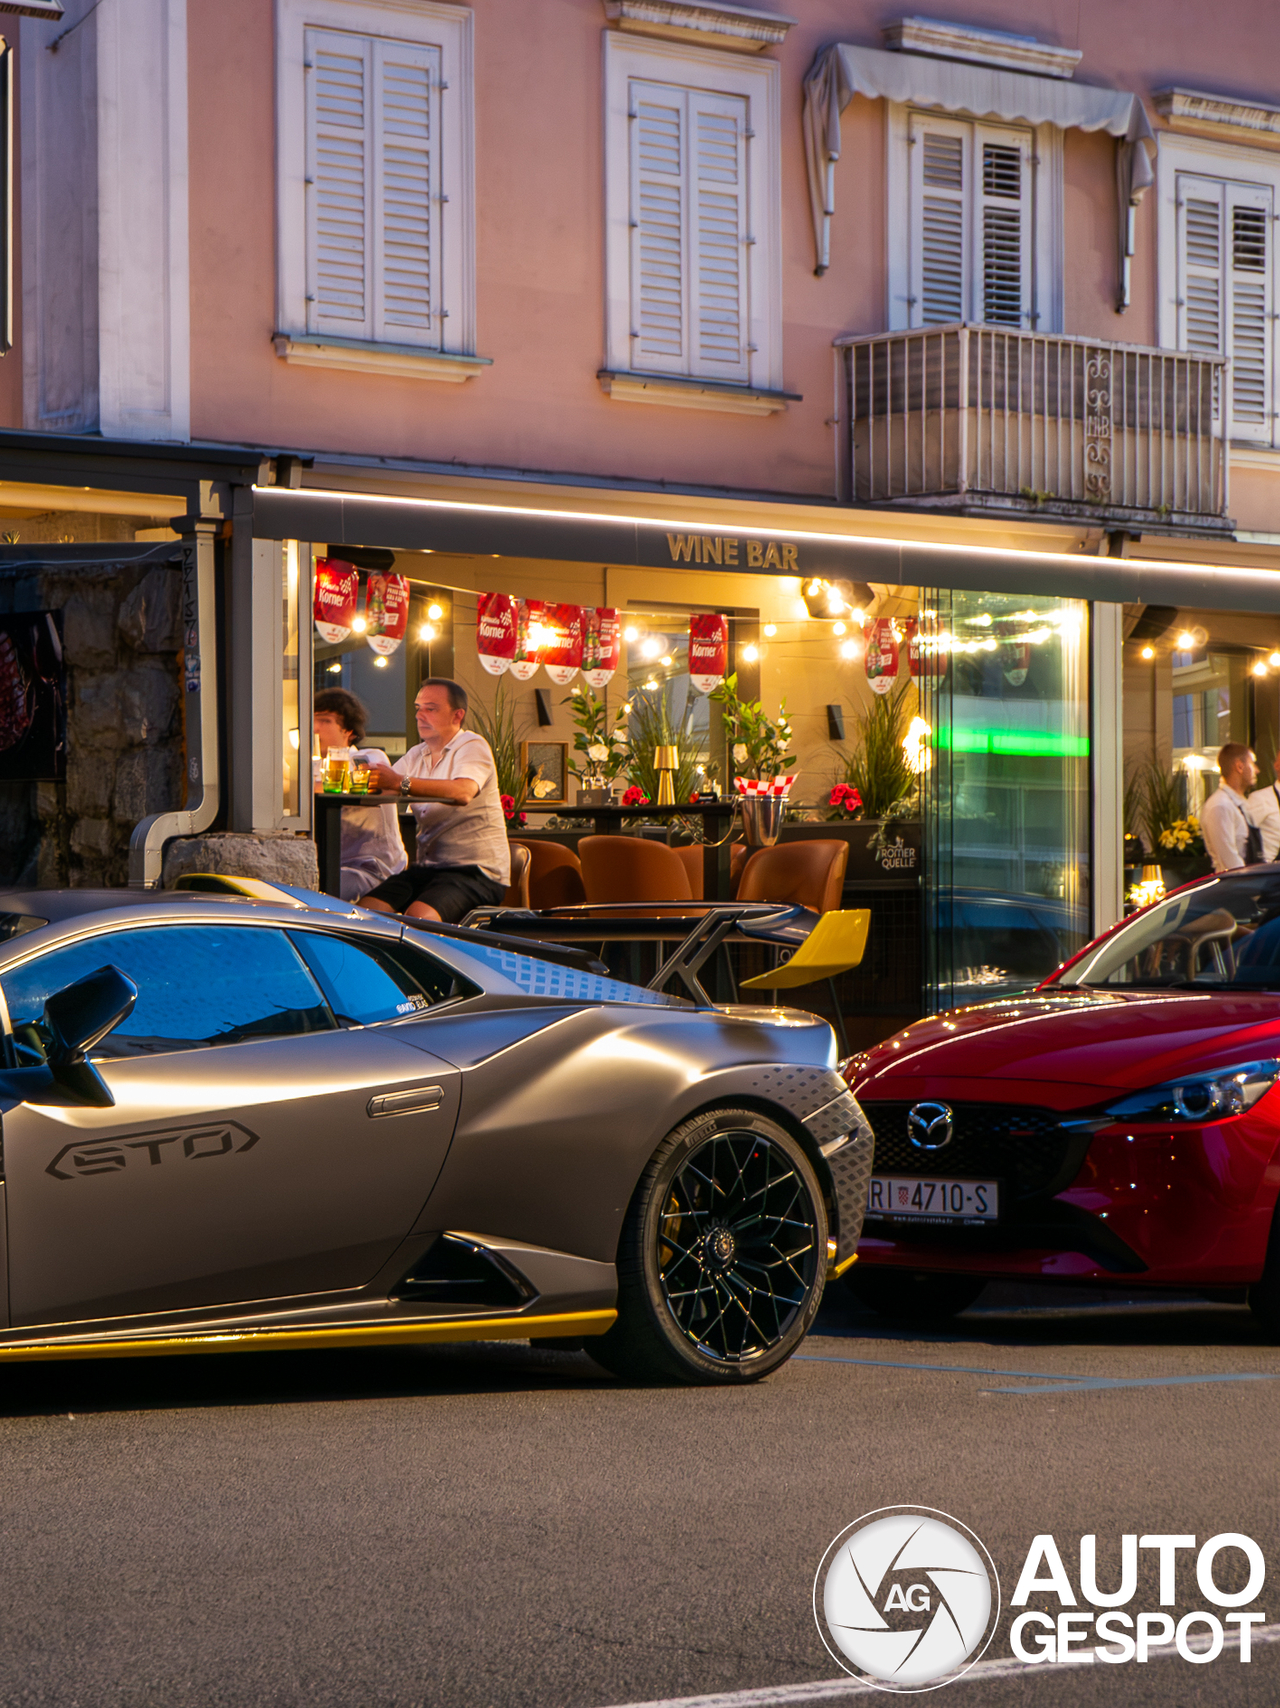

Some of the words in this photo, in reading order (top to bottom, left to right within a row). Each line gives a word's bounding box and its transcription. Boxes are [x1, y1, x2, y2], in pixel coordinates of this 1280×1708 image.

[666, 532, 740, 566] WINE
[746, 539, 800, 571] BAR
[318, 587, 345, 608] Korner
[479, 621, 506, 640] Korner
[691, 643, 717, 658] Korner
[881, 857, 917, 870] QUELLE
[73, 1129, 234, 1176] STO
[871, 1180, 892, 1208] RI
[911, 1182, 988, 1214] 4710-S
